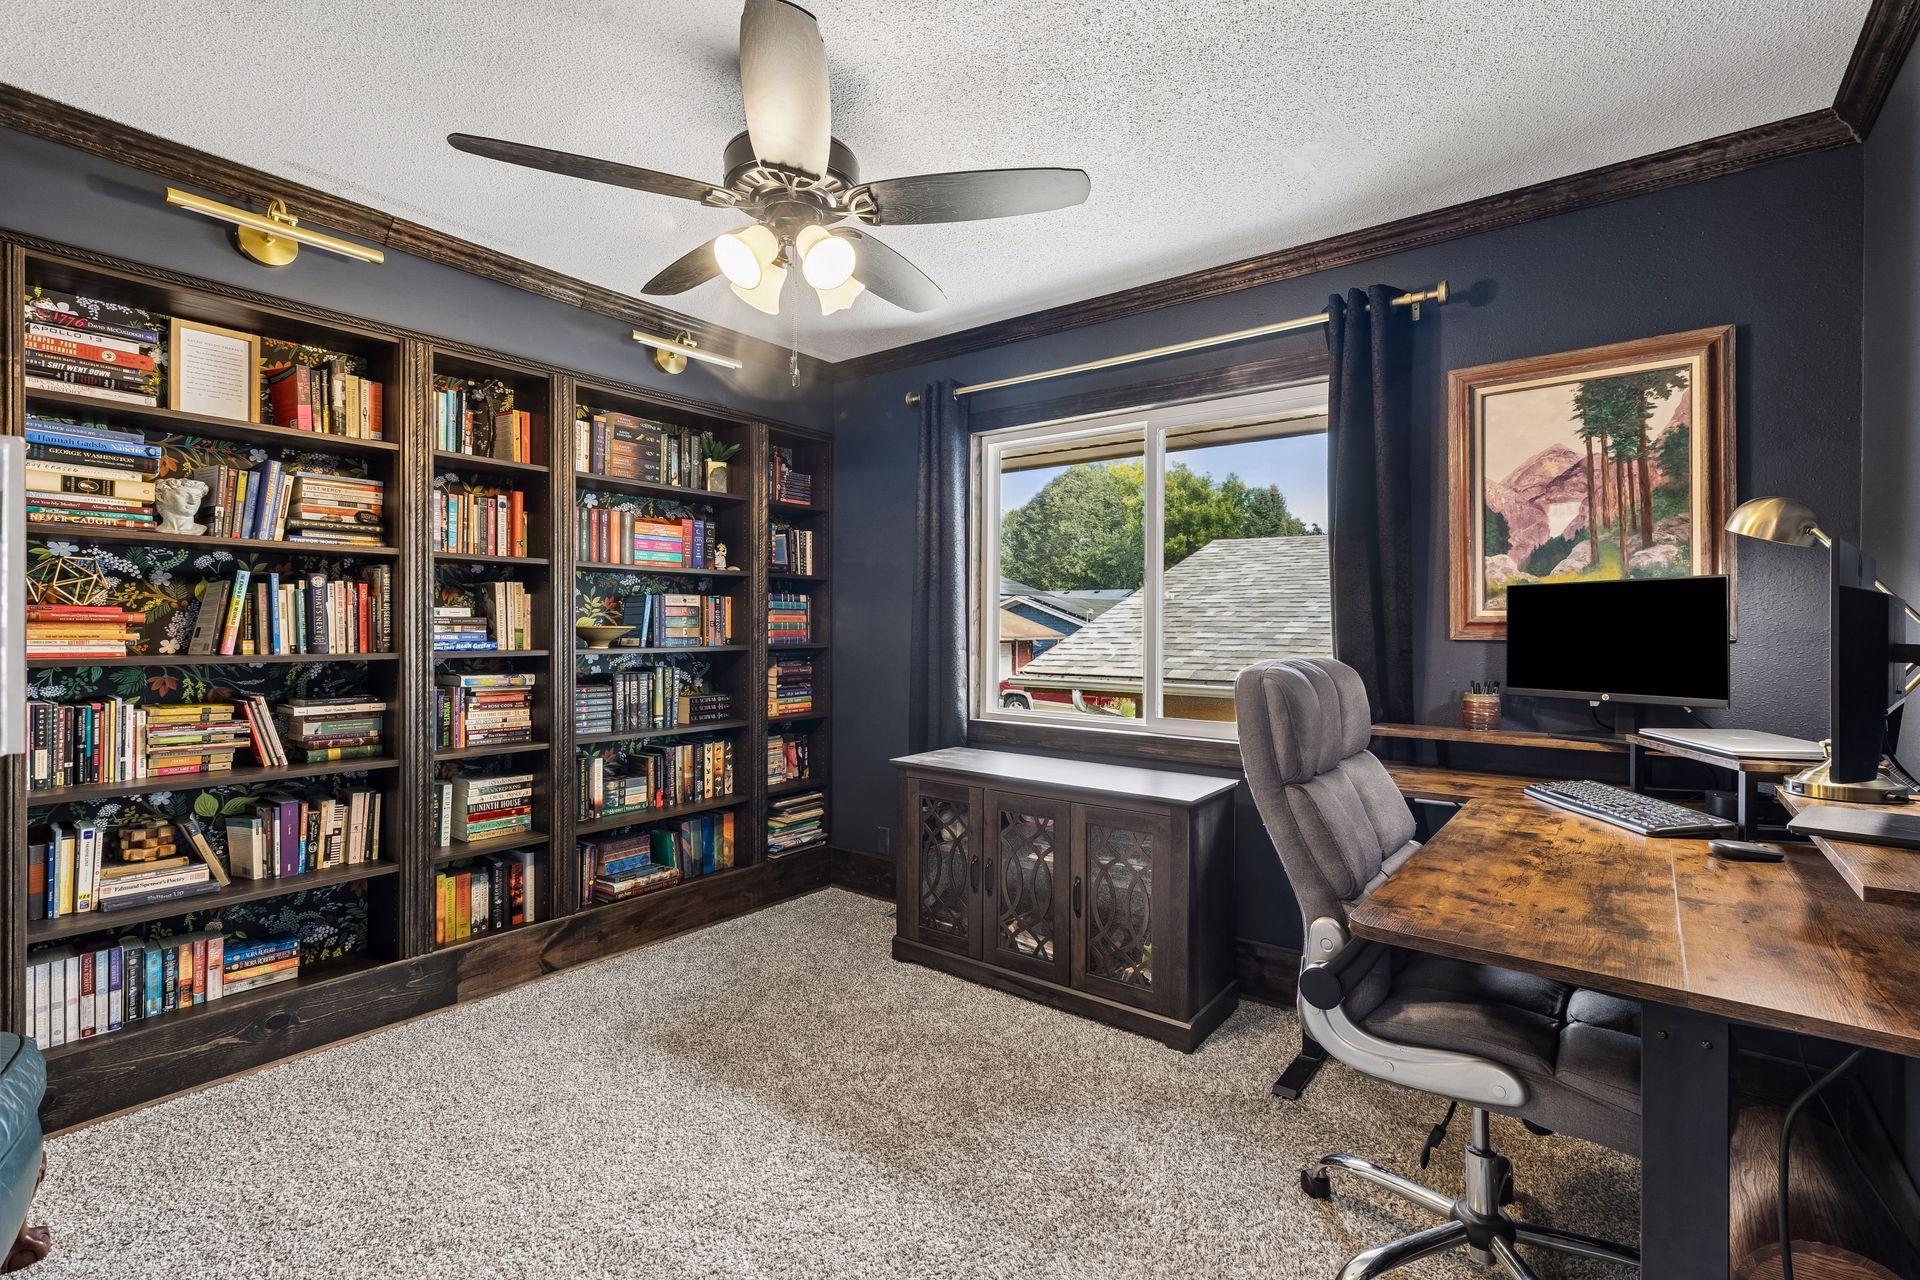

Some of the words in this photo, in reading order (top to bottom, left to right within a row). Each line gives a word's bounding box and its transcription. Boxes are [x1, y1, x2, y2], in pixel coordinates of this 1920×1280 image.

[53, 312, 87, 328] 1776
[31, 325, 82, 339] APOLLO
[89, 335, 103, 343] 13
[67, 364, 87, 374] WENT
[89, 368, 111, 378] DOWN
[37, 434, 75, 445] Hannah
[76, 439, 108, 450] Gadsby
[111, 445, 145, 454] Nanette
[48, 447, 82, 457] GEORGE
[83, 452, 135, 463] WASHINGTON
[30, 513, 68, 523] NEVER
[71, 516, 119, 526] CAUGHT
[237, 580, 245, 594] ENDS
[231, 606, 239, 625] WORLD
[315, 616, 323, 634] NEXT
[616, 681, 624, 710] POWERLESS
[479, 802, 499, 811] NINTH
[501, 798, 521, 808] HOUSE
[114, 882, 140, 892] Edmund
[140, 880, 167, 890] Spenser's
[166, 877, 185, 886] Poetry
